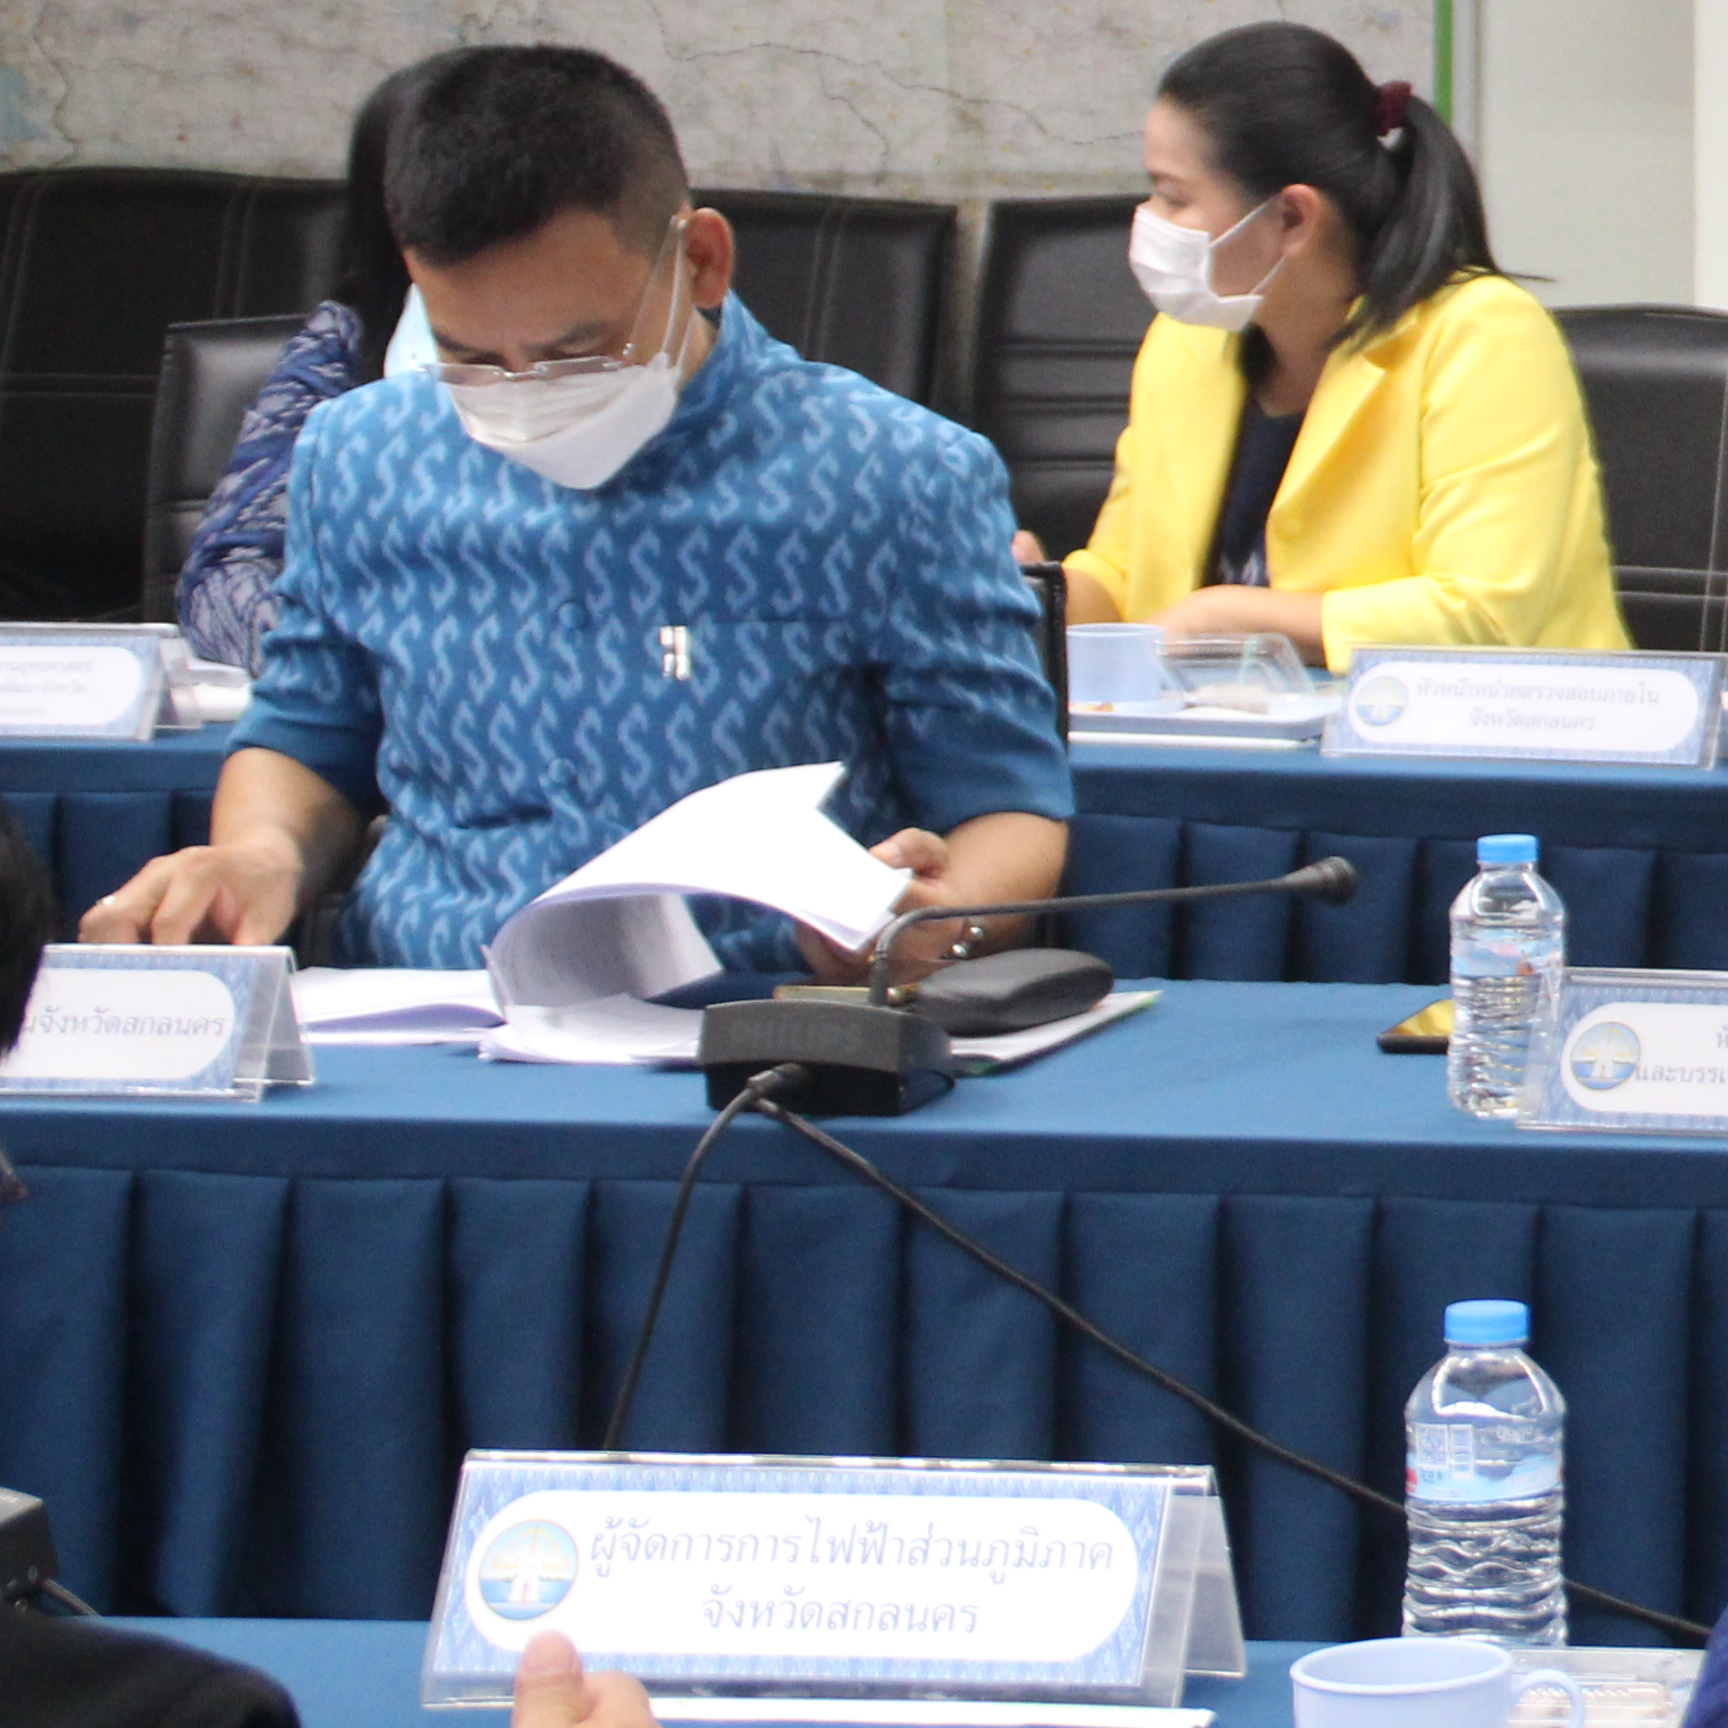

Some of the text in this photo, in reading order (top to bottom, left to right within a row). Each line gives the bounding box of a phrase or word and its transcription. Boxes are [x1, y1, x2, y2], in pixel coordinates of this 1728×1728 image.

[1468, 706, 1596, 731] จังหวัดสกลนคร
[589, 1515, 1114, 1586] ผู้จัดการการไฟฟ้าส่วนภูมิภาค
[702, 1583, 980, 1634] จังหวัดสกลนคร
